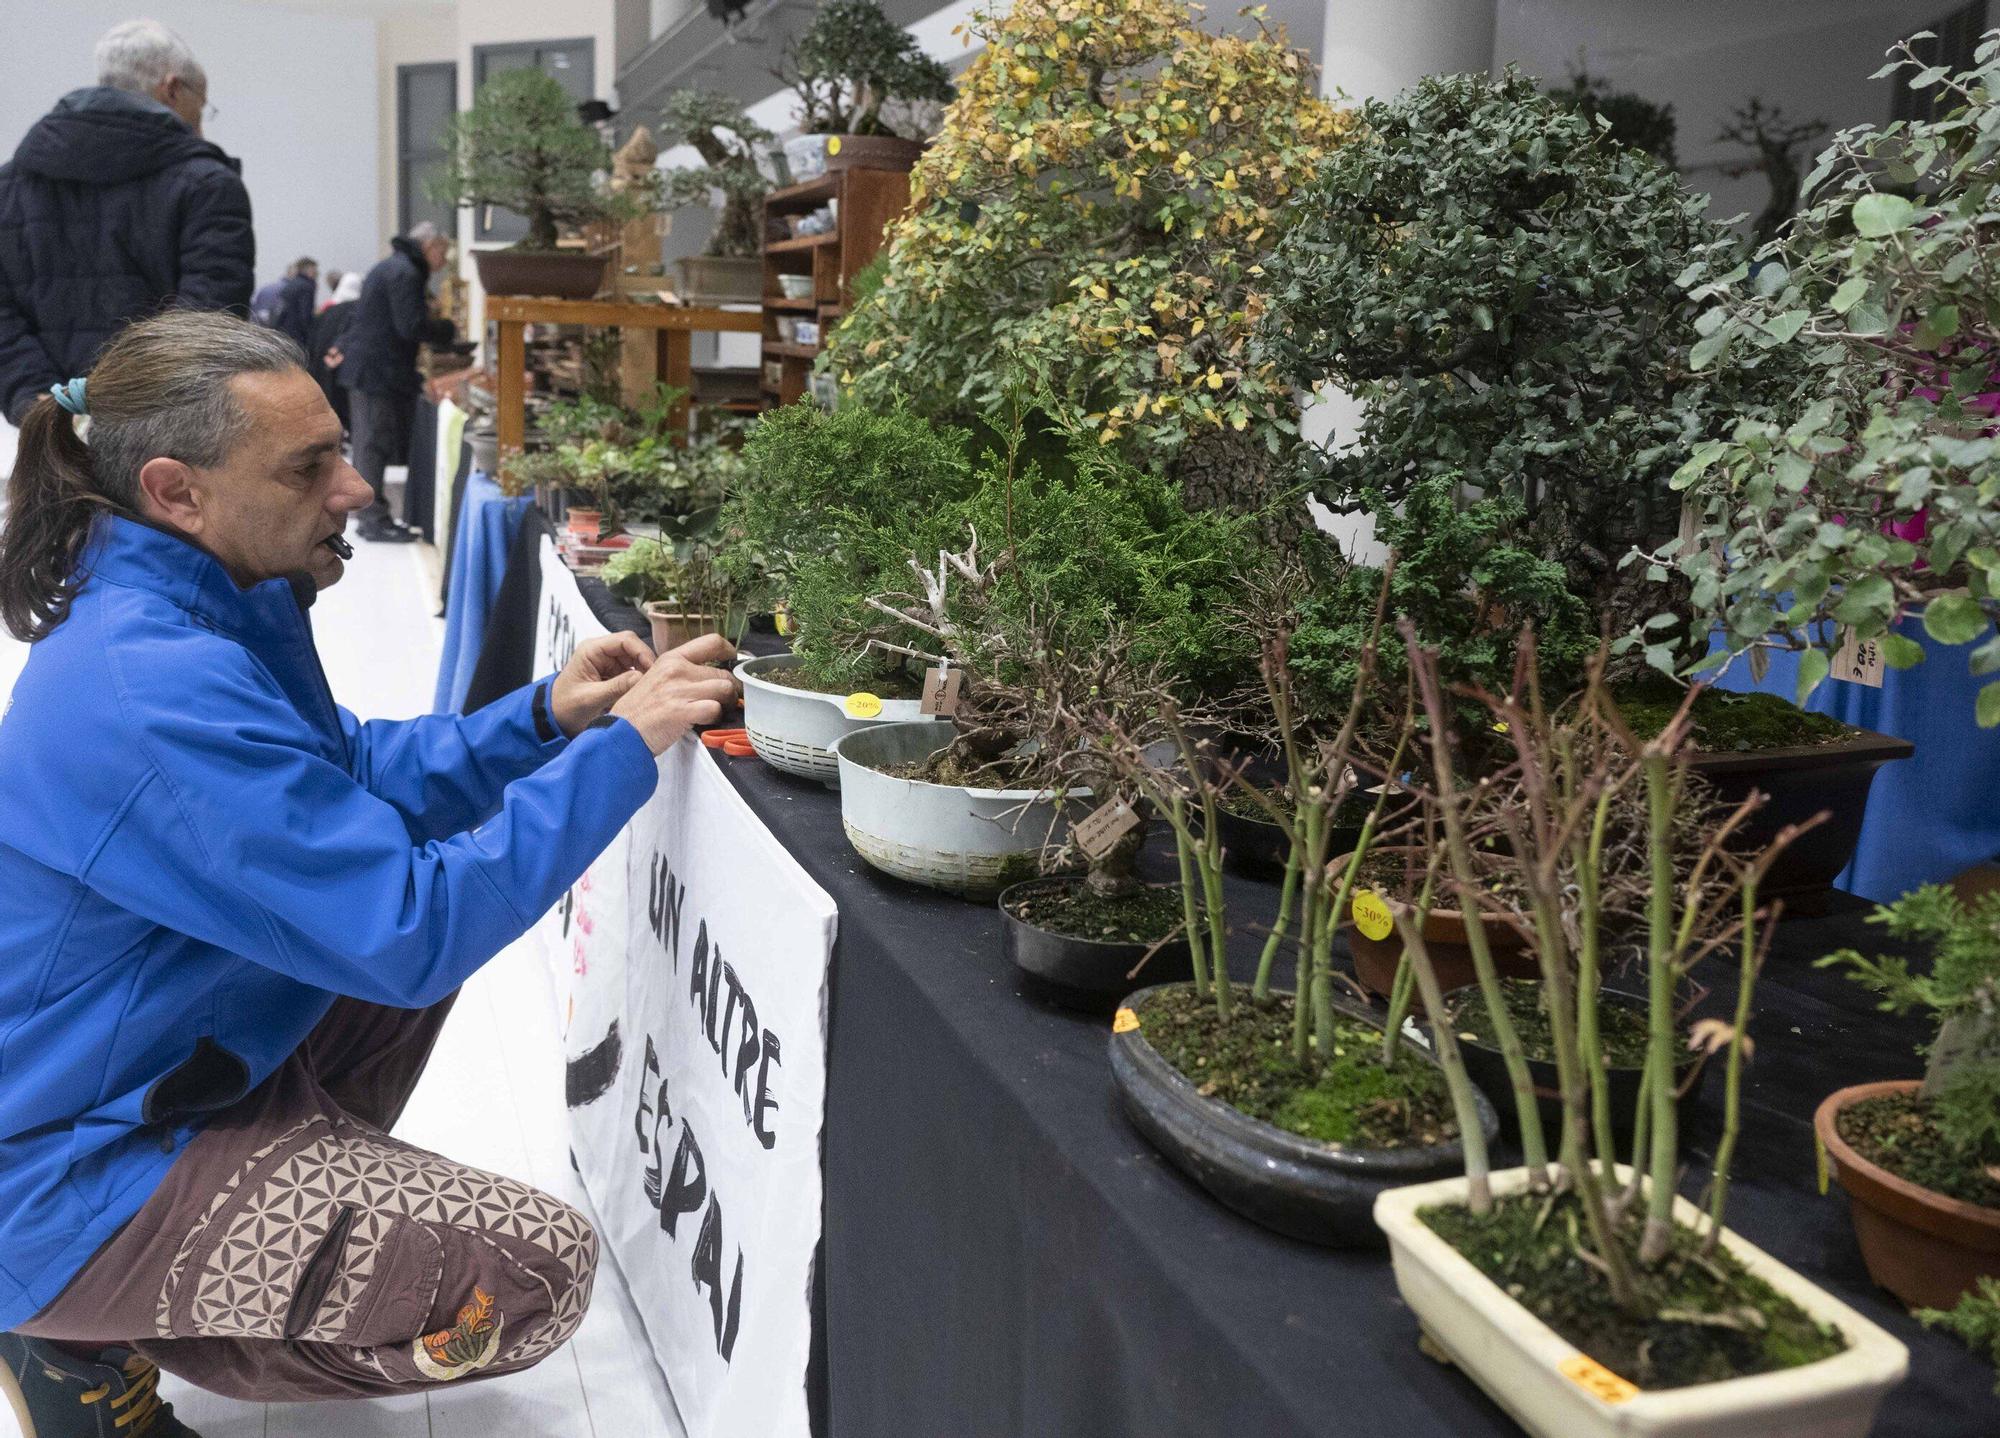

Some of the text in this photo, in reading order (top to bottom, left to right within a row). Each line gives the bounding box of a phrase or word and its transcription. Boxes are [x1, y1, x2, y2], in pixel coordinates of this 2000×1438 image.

[849, 701, 880, 710] -20%
[648, 844, 782, 1150] UN ALTRE
[1354, 905, 1389, 927] -30%
[634, 1032, 746, 1369] ESPAI
